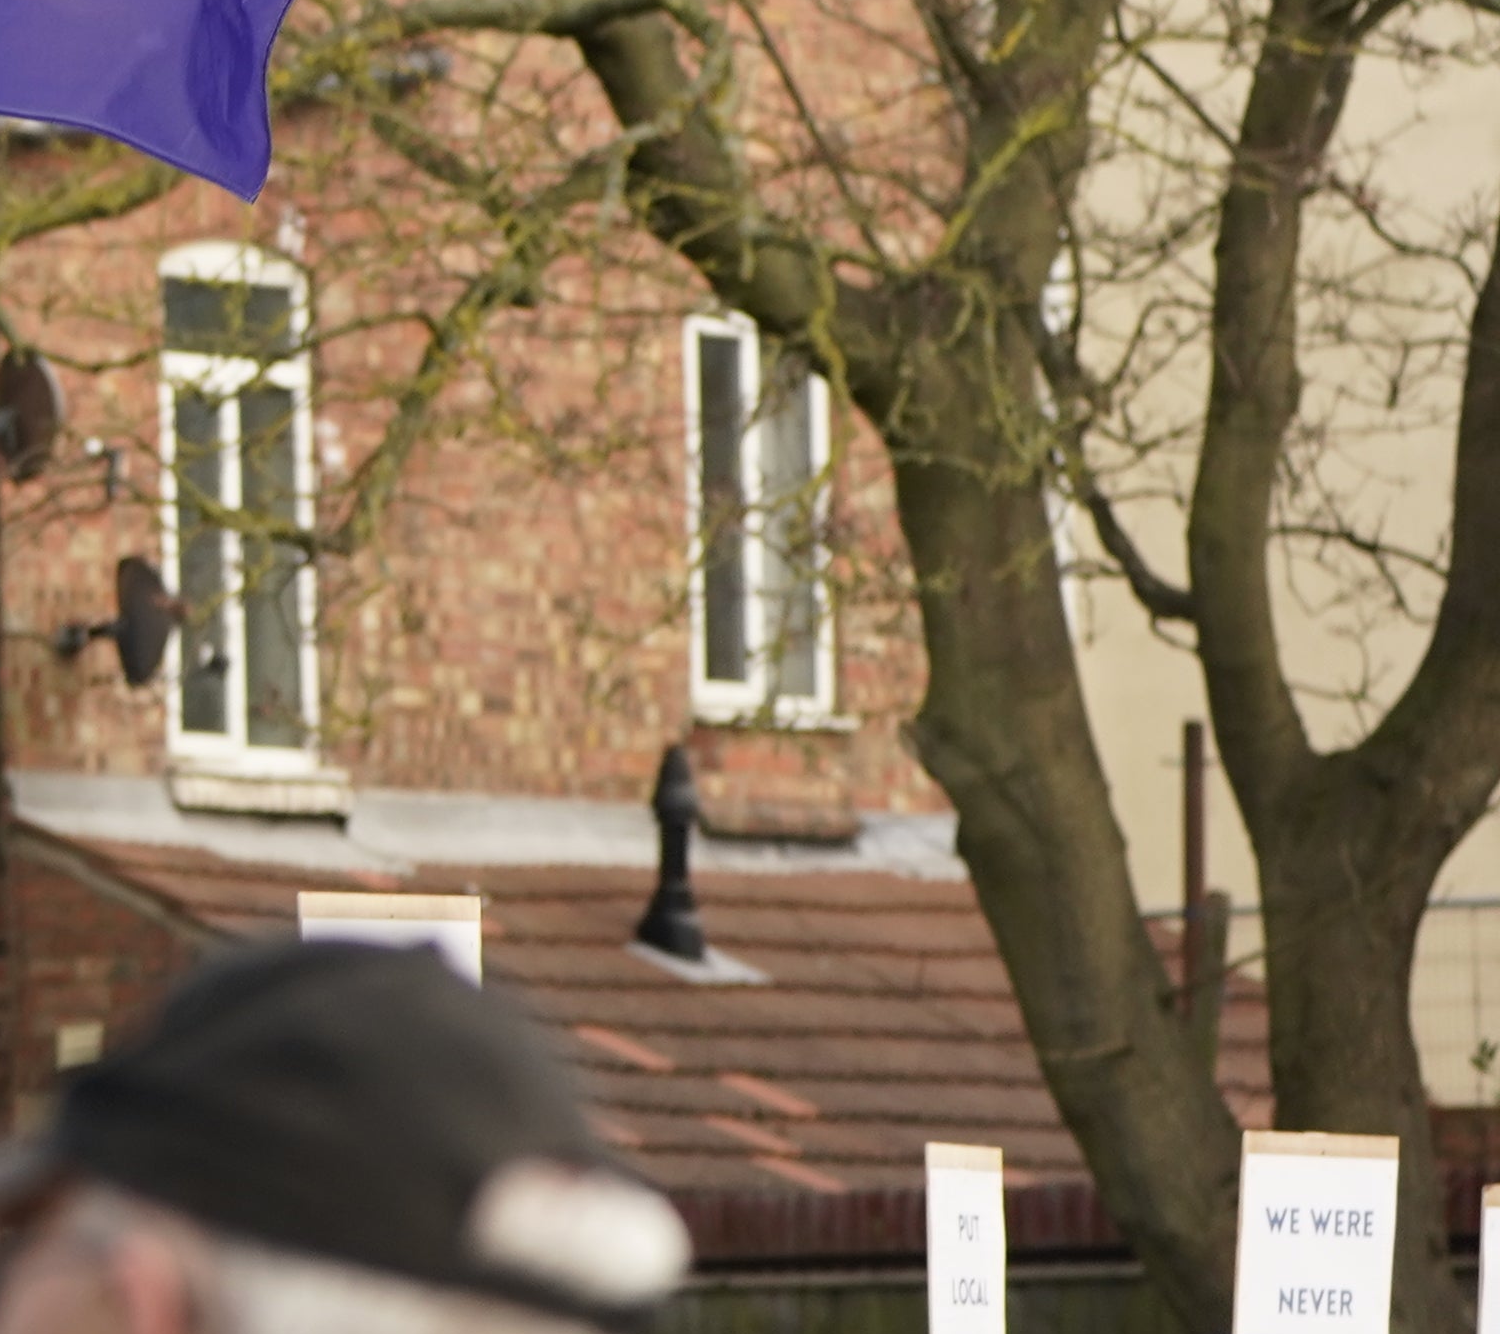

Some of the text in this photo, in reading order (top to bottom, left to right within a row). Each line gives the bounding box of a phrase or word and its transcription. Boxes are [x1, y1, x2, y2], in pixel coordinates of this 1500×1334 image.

[958, 1214, 980, 1241] PUT
[1266, 1207, 1375, 1237] WE WERE
[952, 1278, 988, 1306] LOCAL
[1278, 1287, 1354, 1316] NEVER
